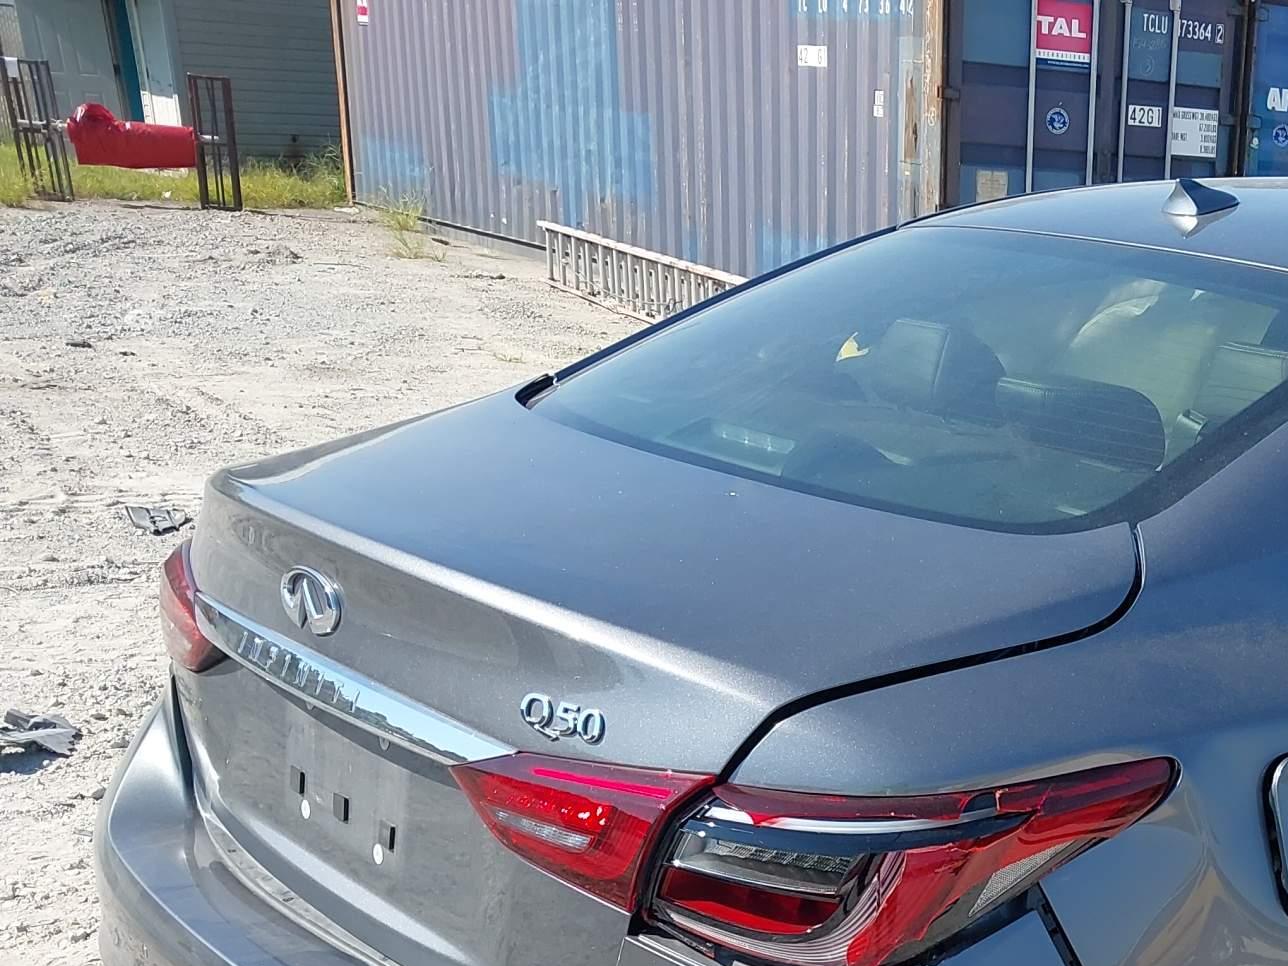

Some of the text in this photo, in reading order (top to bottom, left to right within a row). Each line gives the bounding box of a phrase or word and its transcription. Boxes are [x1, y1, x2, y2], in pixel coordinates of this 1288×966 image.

[1037, 15, 1087, 39] TAL
[1143, 13, 1224, 43] TCLU 73364 2
[1129, 106, 1161, 126] 42G1
[237, 630, 361, 714] INFINITI
[520, 692, 606, 746] Q50
